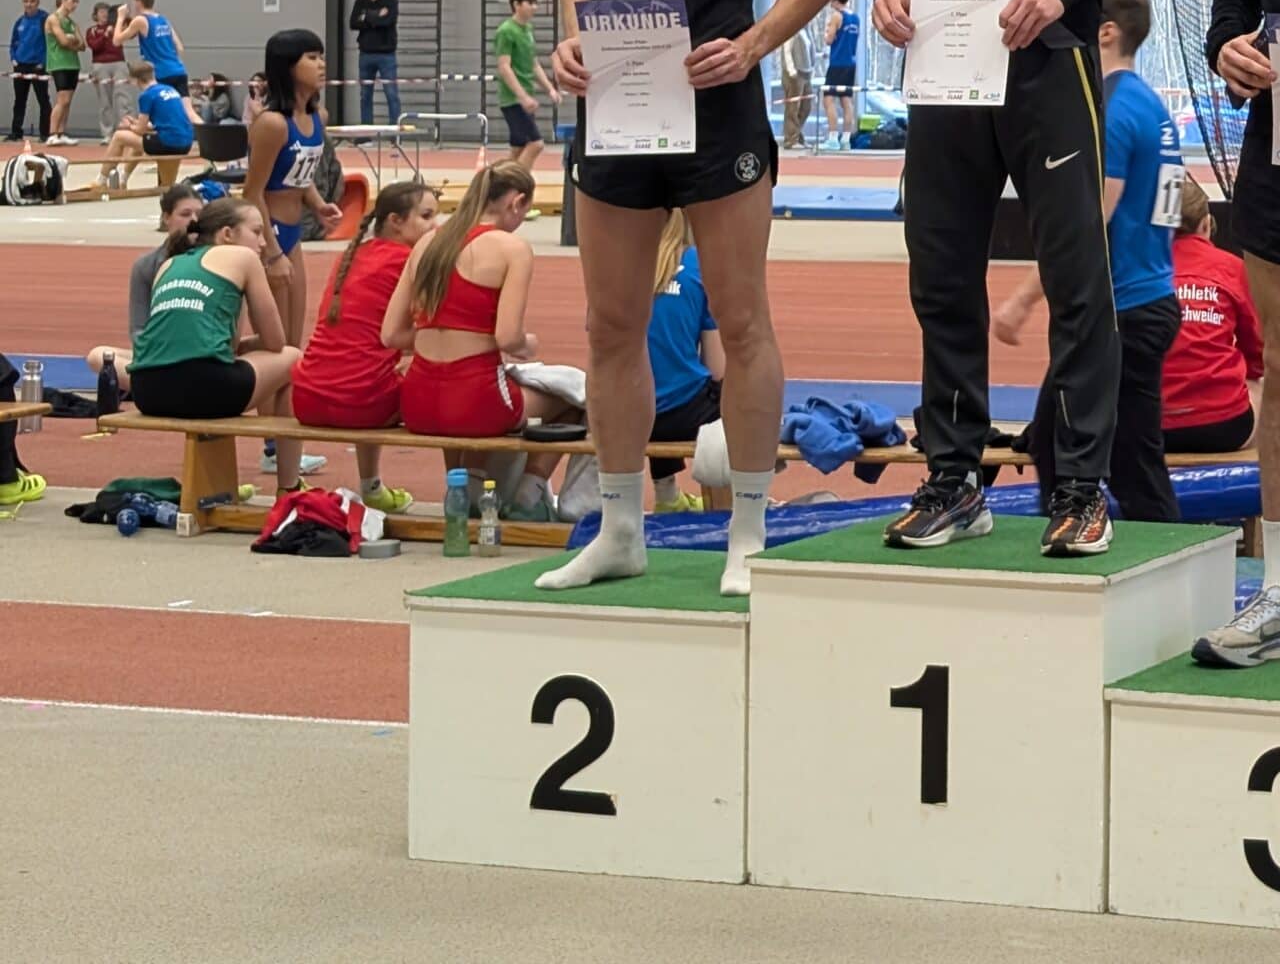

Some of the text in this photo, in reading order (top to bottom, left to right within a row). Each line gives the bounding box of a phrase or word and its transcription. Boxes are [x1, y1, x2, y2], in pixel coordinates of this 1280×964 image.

[584, 11, 682, 32] URKUNDE
[153, 278, 215, 297] rankenthal
[1175, 283, 1219, 303] thletik
[1181, 304, 1225, 326] chweiler
[530, 676, 616, 815] 2
[891, 666, 948, 804] 1
